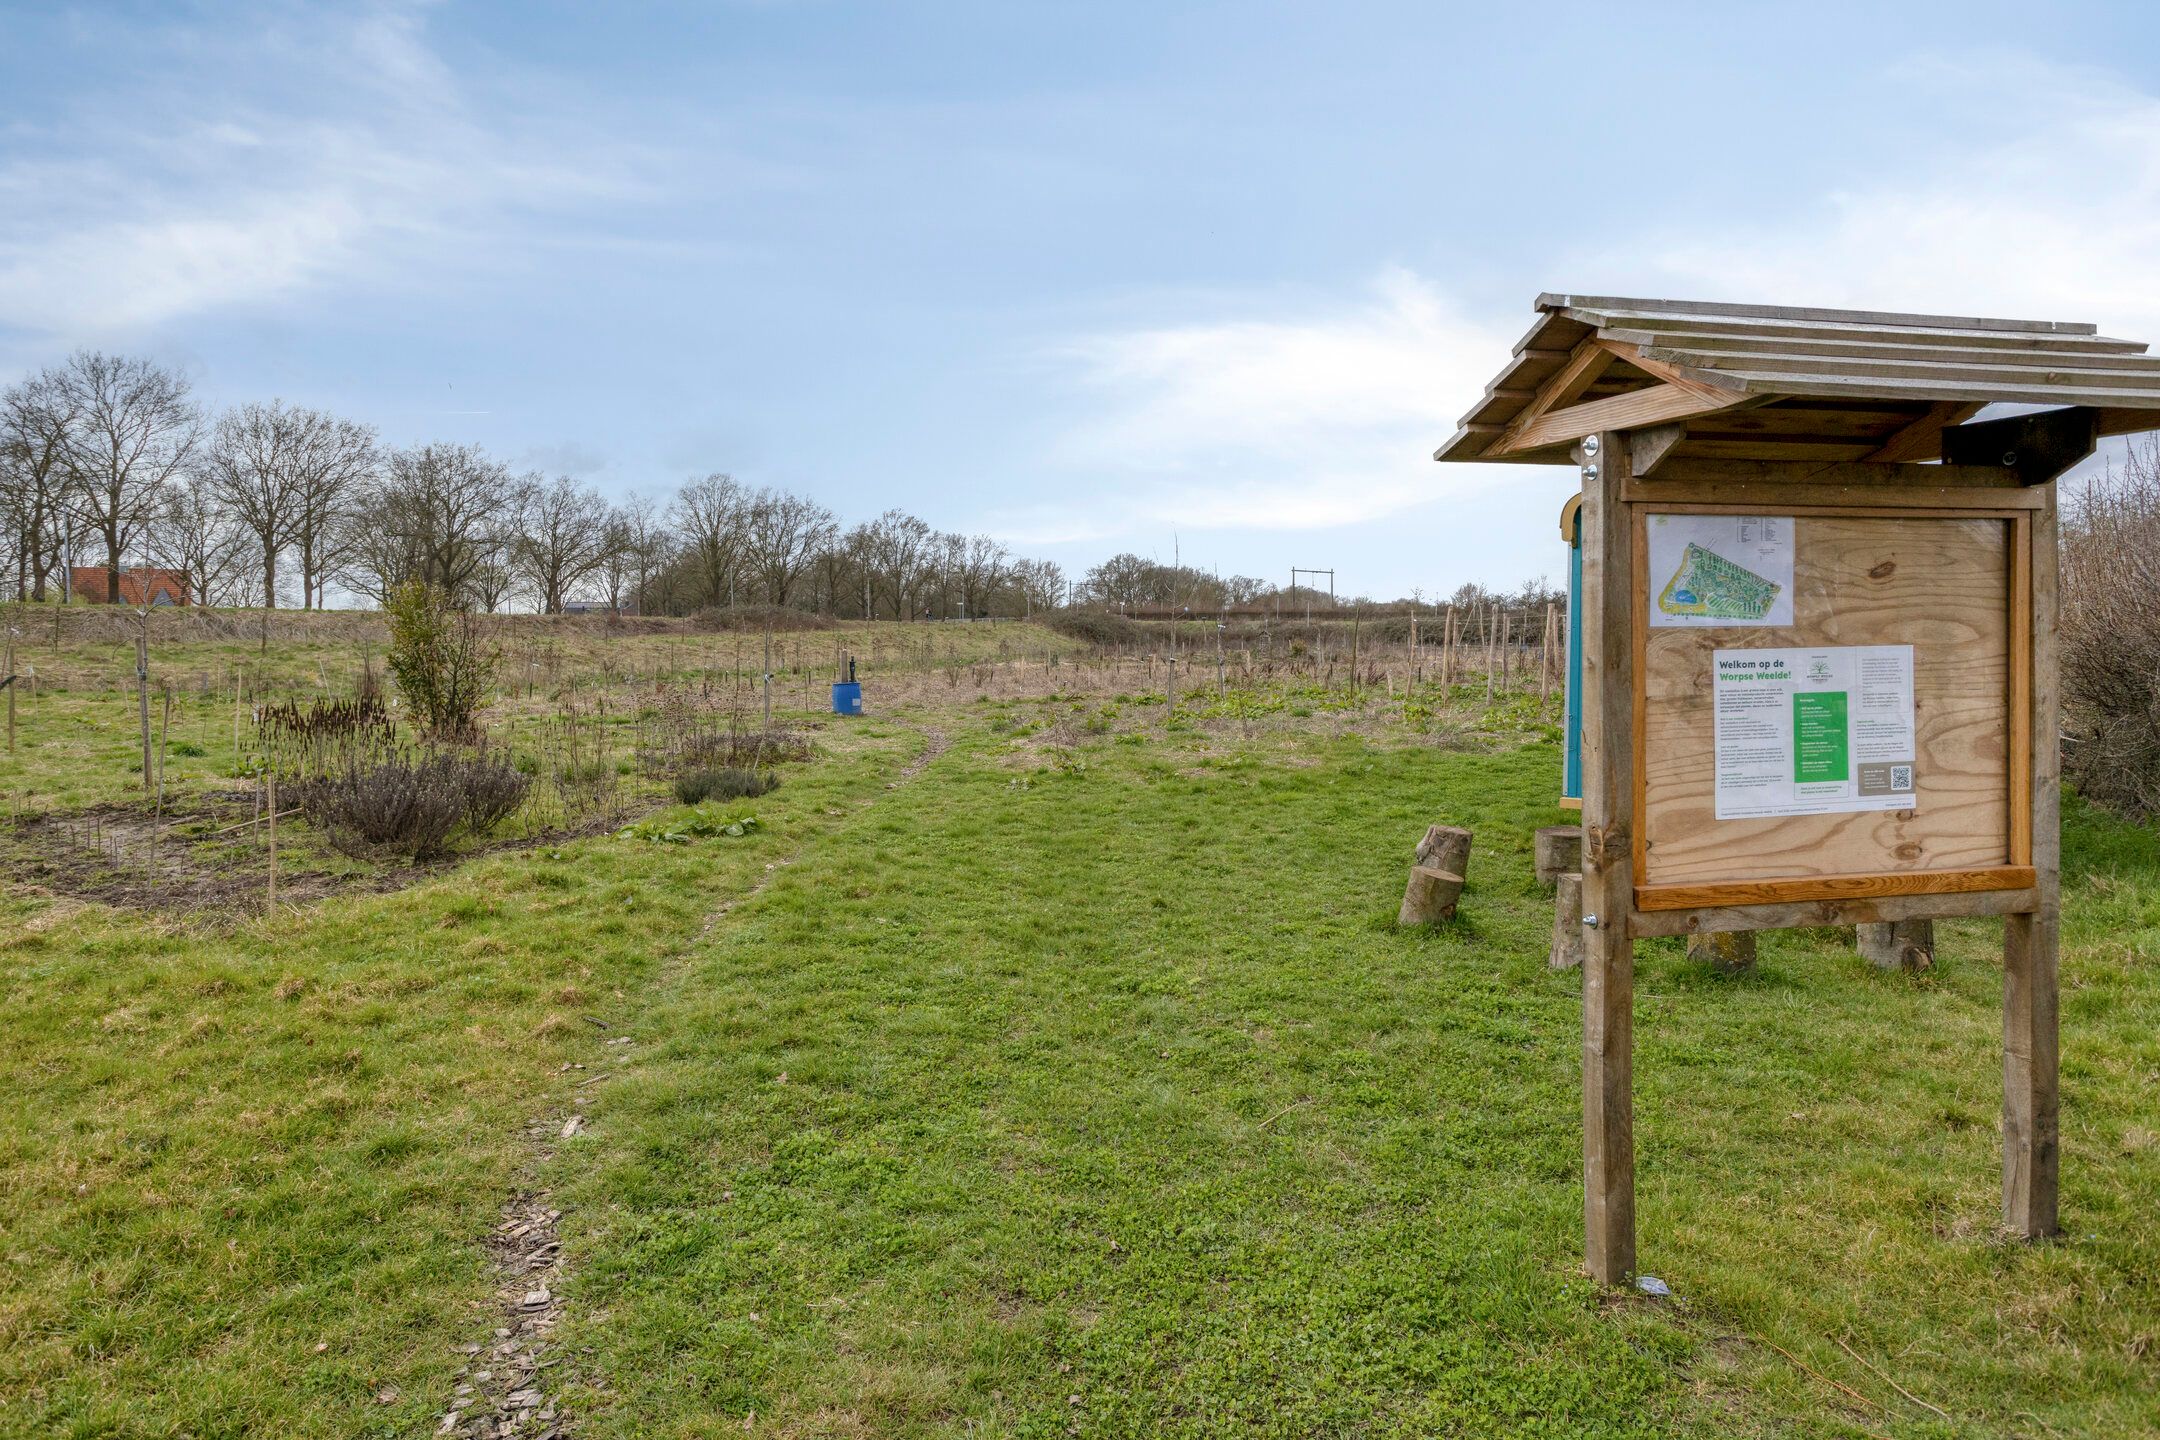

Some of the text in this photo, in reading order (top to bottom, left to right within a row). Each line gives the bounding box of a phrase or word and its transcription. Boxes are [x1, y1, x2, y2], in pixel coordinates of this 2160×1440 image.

[1719, 659, 1784, 670] Welkom op de
[1719, 671, 1792, 683] Worpse Weelde!
